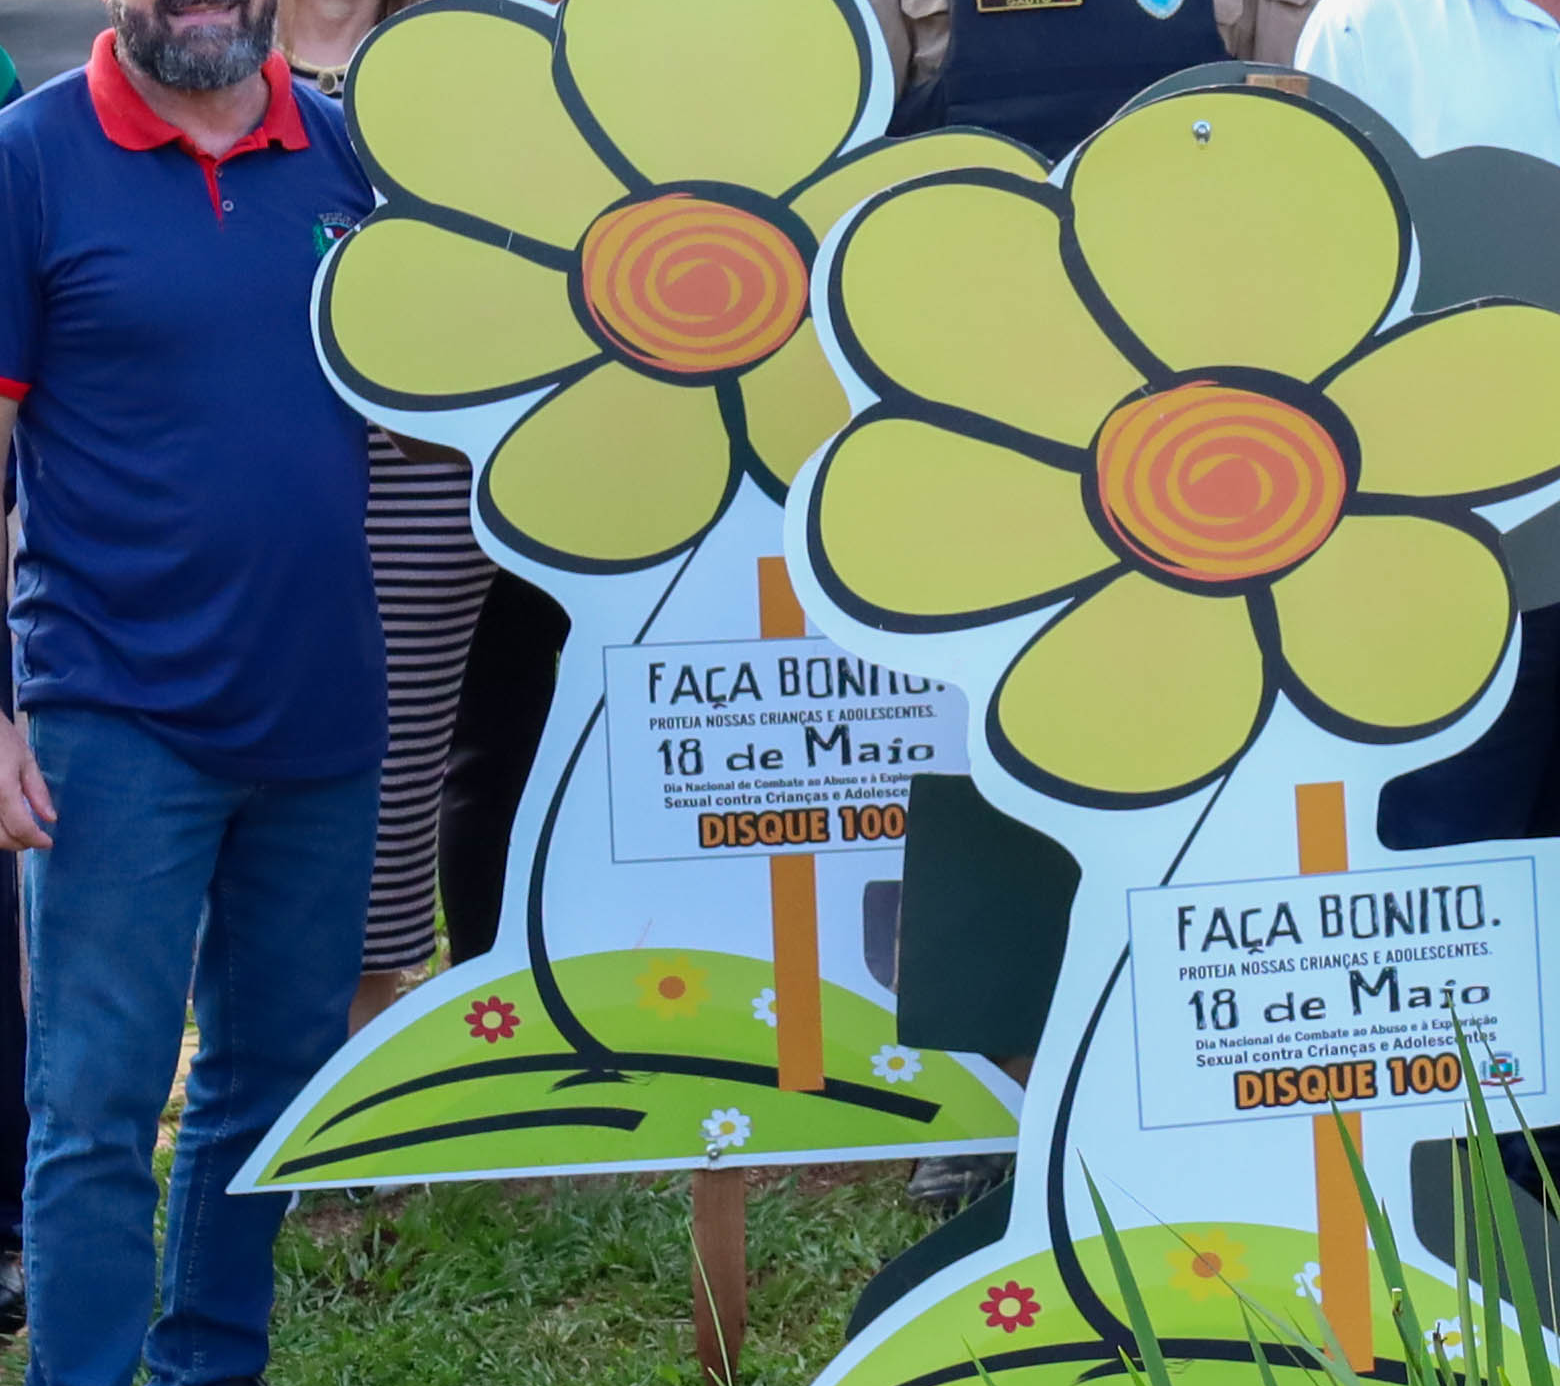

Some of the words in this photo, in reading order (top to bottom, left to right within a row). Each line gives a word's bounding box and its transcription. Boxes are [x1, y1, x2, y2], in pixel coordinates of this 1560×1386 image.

[648, 661, 763, 709] FAÇA
[649, 715, 702, 730] PROTEJA
[706, 713, 756, 727] NOSSAS
[760, 710, 823, 726] CRIANÇAS
[827, 709, 835, 722] E
[838, 704, 938, 721] ADOLESCENTES.
[657, 738, 704, 775] 18
[726, 743, 784, 771] de
[804, 724, 935, 767] Maio
[664, 783, 683, 793] Dia
[685, 780, 735, 792] Nacional
[737, 780, 751, 789] de
[754, 777, 804, 789] Combate
[824, 775, 858, 785] Abuso
[861, 776, 867, 784] e
[870, 773, 877, 784] à
[664, 795, 712, 809] Sexual
[715, 793, 762, 807] contra
[766, 791, 829, 805] Crianças
[832, 791, 841, 801] e
[844, 786, 910, 800] Adolesce
[698, 808, 831, 849] DISQUE
[838, 803, 907, 842] 100
[1177, 901, 1304, 955] FAÇA
[1318, 884, 1502, 940] BONITO.
[1179, 963, 1237, 981] PROTEJA
[1241, 958, 1296, 976] NOSSAS
[1300, 951, 1369, 971] CRIANÇAS
[1373, 950, 1382, 964] E
[1385, 941, 1493, 963] ADOLESCENTES.
[1188, 988, 1240, 1031] 18
[1263, 992, 1327, 1023] de
[1349, 966, 1491, 1016] Maio
[1195, 1039, 1217, 1050] Dia
[1219, 1034, 1274, 1049] Nacional
[1277, 1033, 1292, 1044] de
[1295, 1028, 1350, 1042] Combate
[1352, 1028, 1368, 1037] ao
[1370, 1024, 1408, 1035] Abuso
[1410, 1023, 1418, 1032] e
[1421, 1020, 1429, 1031] à
[1196, 1050, 1248, 1068] Sexual
[1252, 1048, 1304, 1063] contra
[1307, 1042, 1377, 1058] Crianças
[1380, 1041, 1389, 1051] e
[1392, 1031, 1497, 1050] Adolescntes
[1233, 1060, 1378, 1111] DISQUE
[1386, 1052, 1463, 1097] 100
